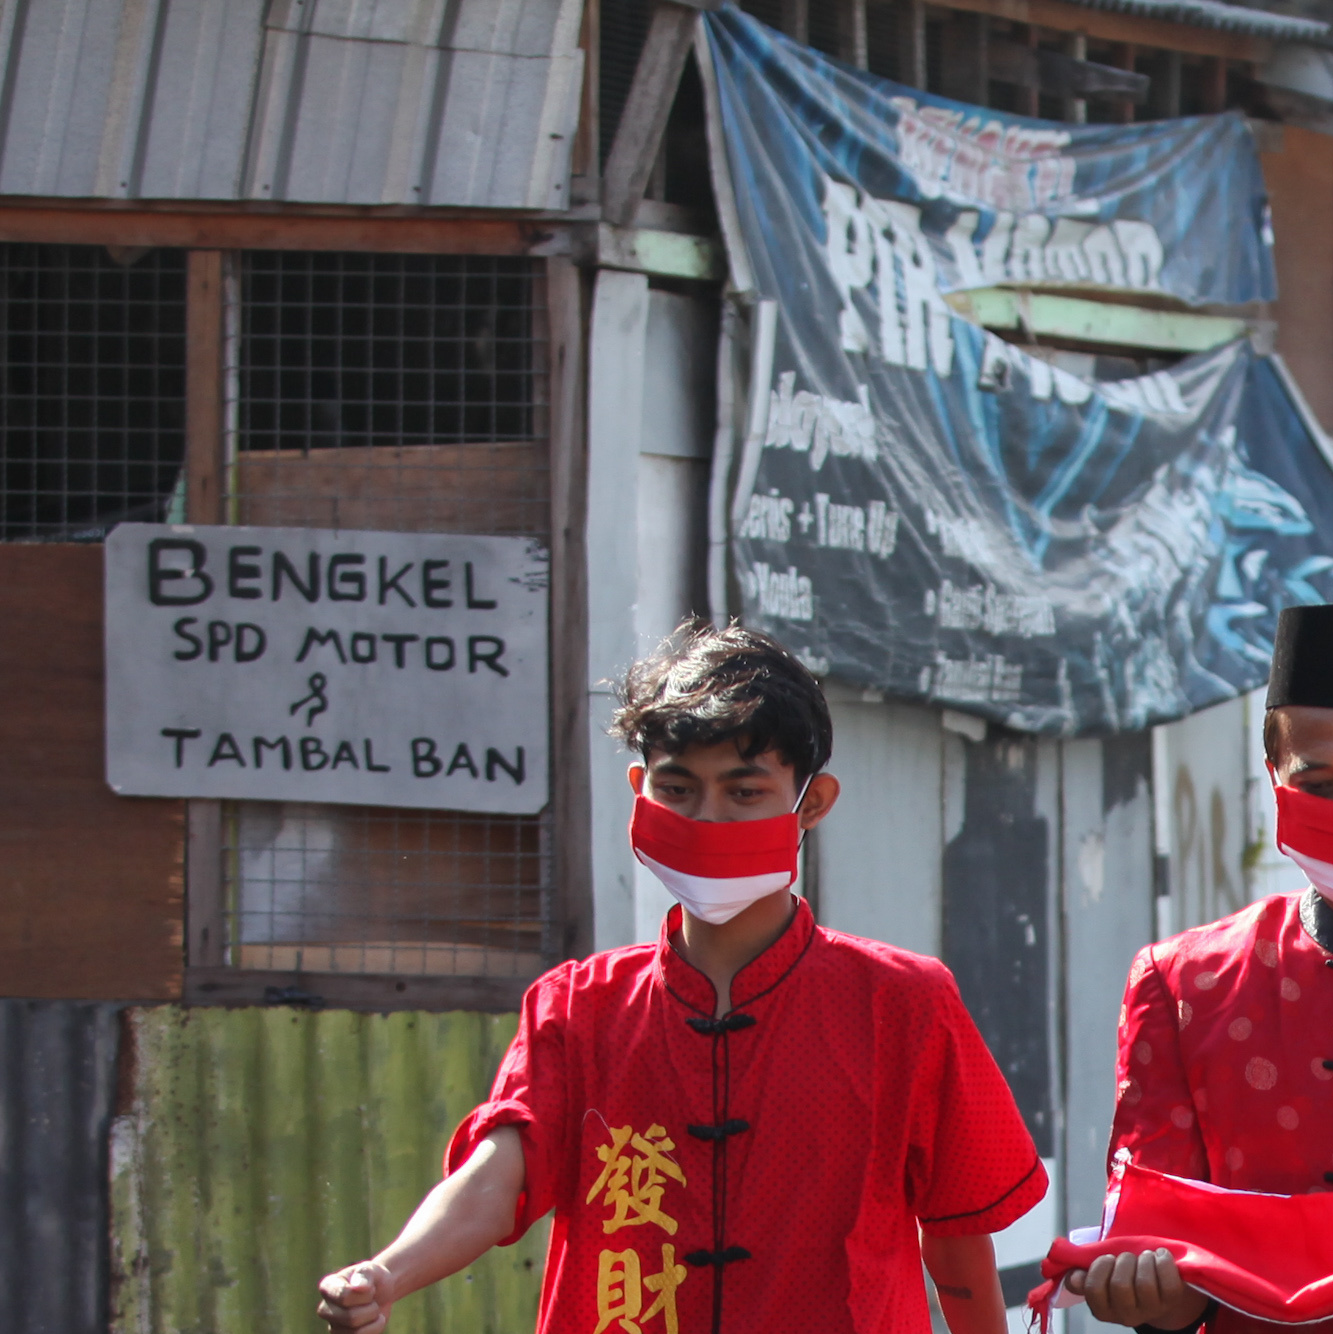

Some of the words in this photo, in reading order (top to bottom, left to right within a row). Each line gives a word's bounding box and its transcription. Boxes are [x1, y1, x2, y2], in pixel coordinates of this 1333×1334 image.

[148, 538, 497, 610] BENGKEL
[173, 617, 266, 663] SPD
[295, 626, 510, 677] MOTOR
[161, 727, 390, 773] TAMBAL
[411, 738, 525, 785] BAN
